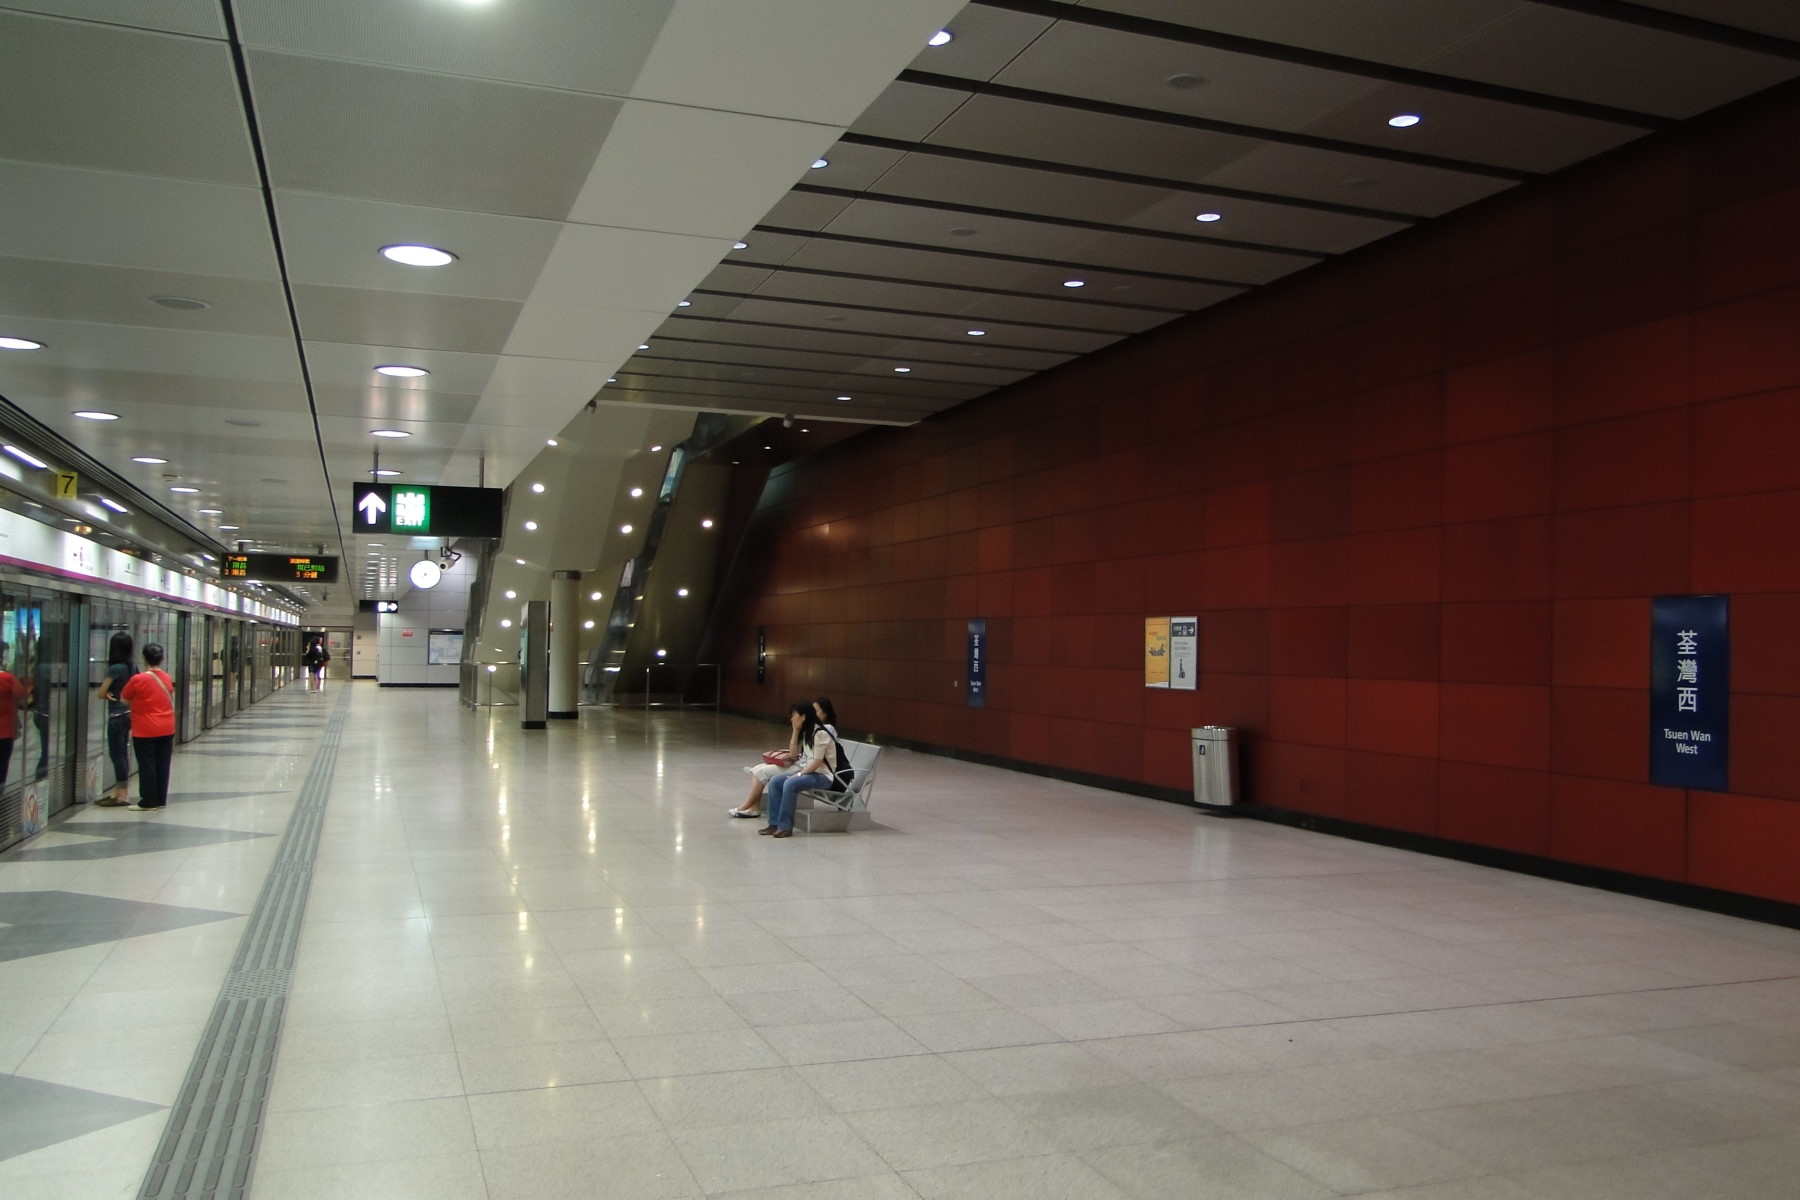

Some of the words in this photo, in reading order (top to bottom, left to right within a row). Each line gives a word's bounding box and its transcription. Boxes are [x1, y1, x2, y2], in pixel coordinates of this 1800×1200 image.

[61, 475, 75, 494] 7
[1676, 629, 1699, 713] 荃灣西
[1663, 728, 1689, 741] Tsuen
[1690, 730, 1711, 743] Wan
[1675, 742, 1699, 755] West
